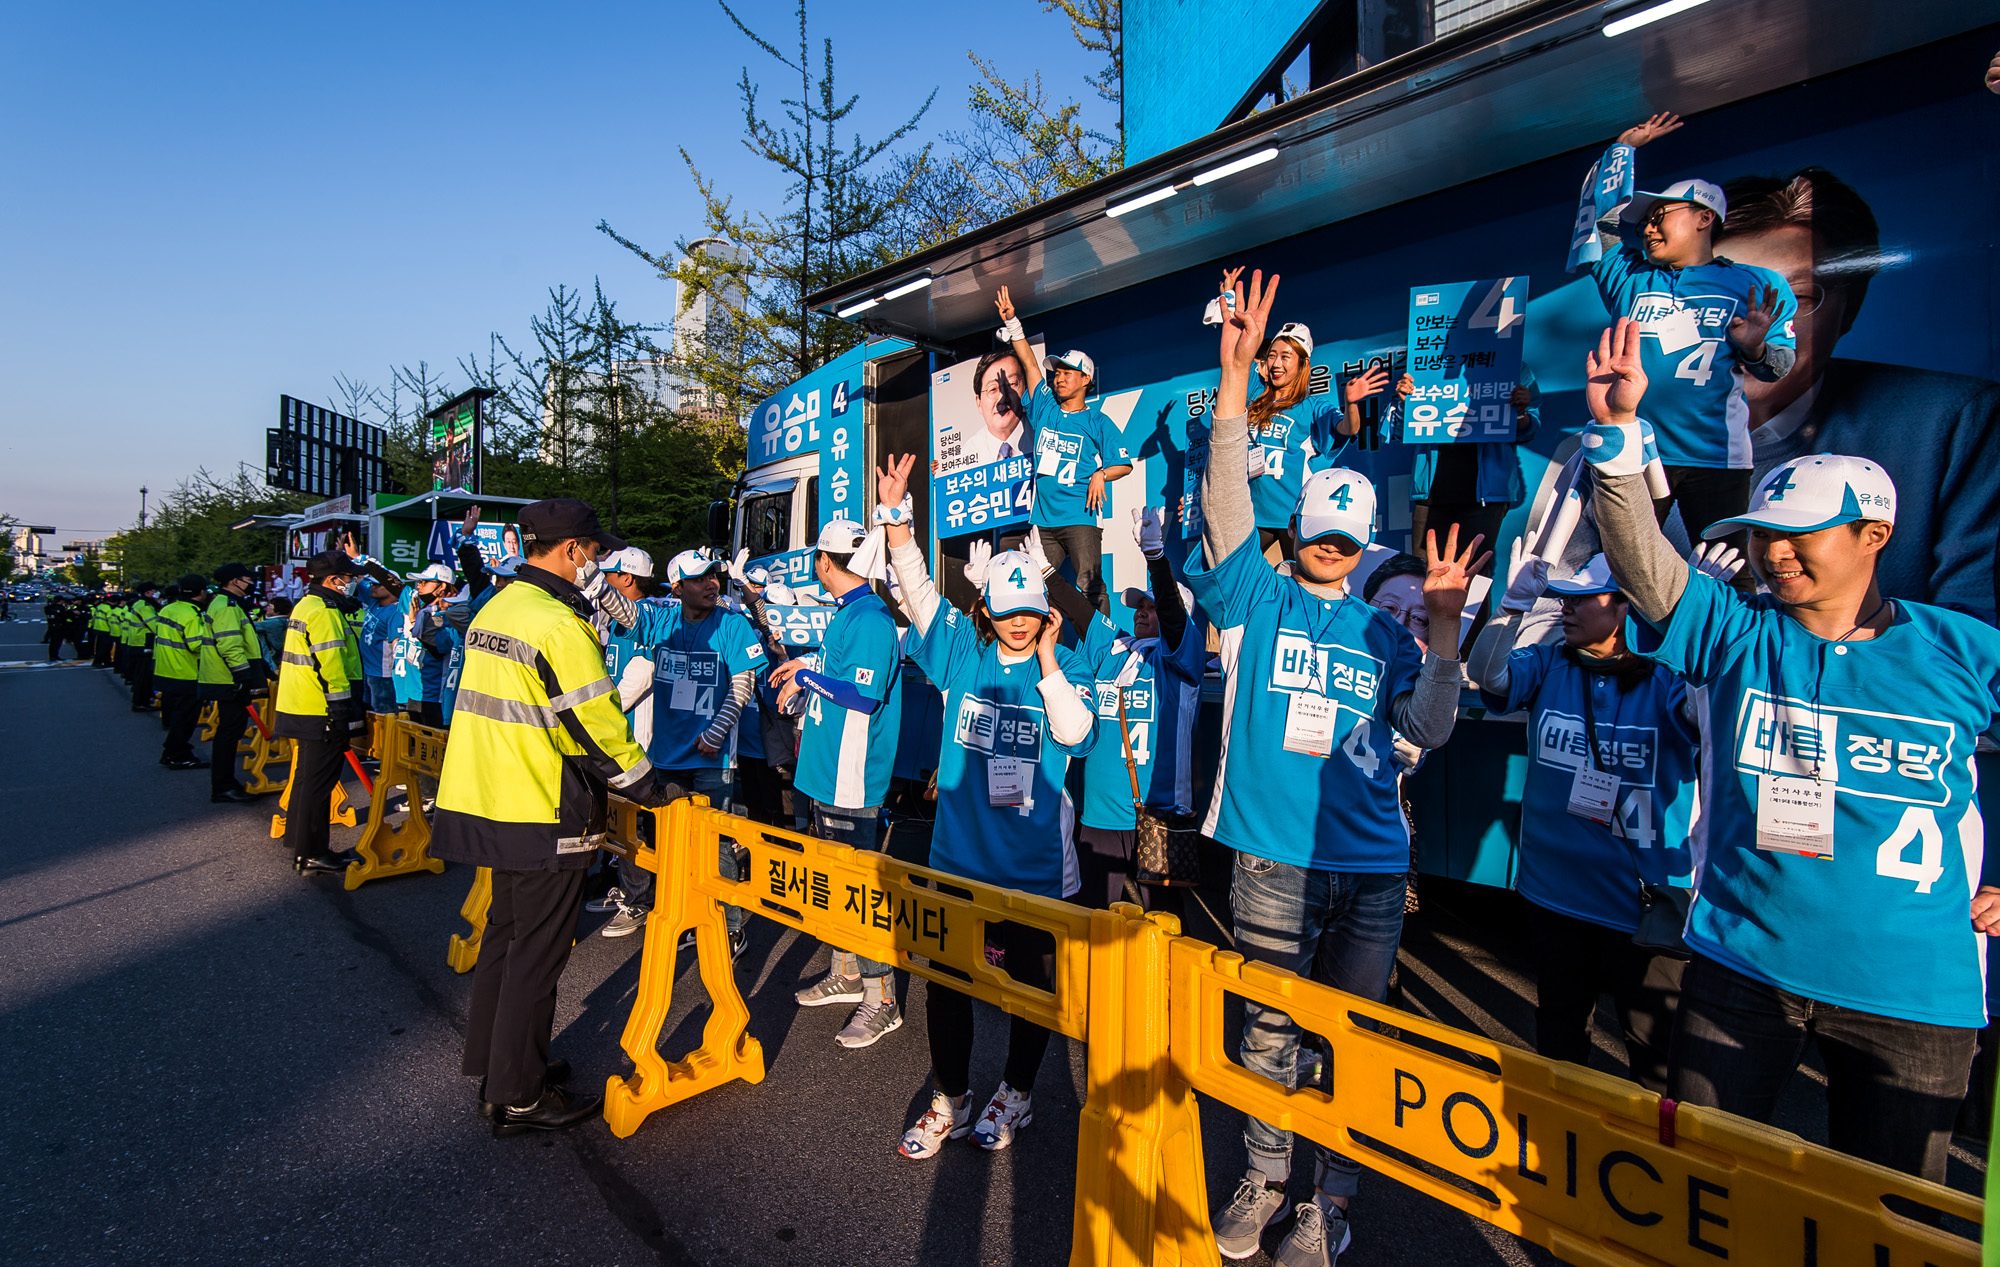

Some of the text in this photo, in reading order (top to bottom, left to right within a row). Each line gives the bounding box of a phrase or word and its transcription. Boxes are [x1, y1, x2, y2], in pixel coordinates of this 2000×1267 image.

[1415, 314, 1460, 331] 안보는
[1468, 277, 1526, 338] 4
[1414, 334, 1449, 351] 보수!
[1414, 351, 1496, 371] 민생은 개혁!
[1674, 341, 1719, 387] 4
[832, 382, 847, 413] 4
[1410, 381, 1516, 402] 보수의 새희망
[1408, 403, 1510, 437] 유승민
[940, 431, 962, 447] 당신의
[941, 444, 962, 460] 능력을
[941, 453, 979, 472] 보여주세요!
[1057, 461, 1077, 487] 4
[1265, 450, 1284, 480] 4
[945, 470, 987, 496] 보수의
[1328, 483, 1353, 510] 4
[1763, 467, 1796, 501] 4
[946, 479, 1032, 529] 유승민 4
[1859, 493, 1891, 509] 유승민
[1008, 567, 1027, 589] 4
[394, 659, 406, 677] 4
[661, 658, 715, 677] 바른 정당
[1332, 662, 1377, 700] 정당
[695, 687, 715, 720] 4
[808, 692, 822, 726] 4
[961, 709, 1039, 745] 바른 정당
[1121, 722, 1150, 765] 4
[1342, 716, 1380, 778] 4
[1599, 741, 1650, 769] 정당
[1755, 717, 1941, 781] 바른 정당
[1771, 786, 1822, 799] 선거사무원
[1612, 789, 1656, 848] 4
[1876, 806, 1944, 894] 4
[769, 859, 948, 952] 질서를 지킵시다
[1394, 1067, 1729, 1261] POLICE
